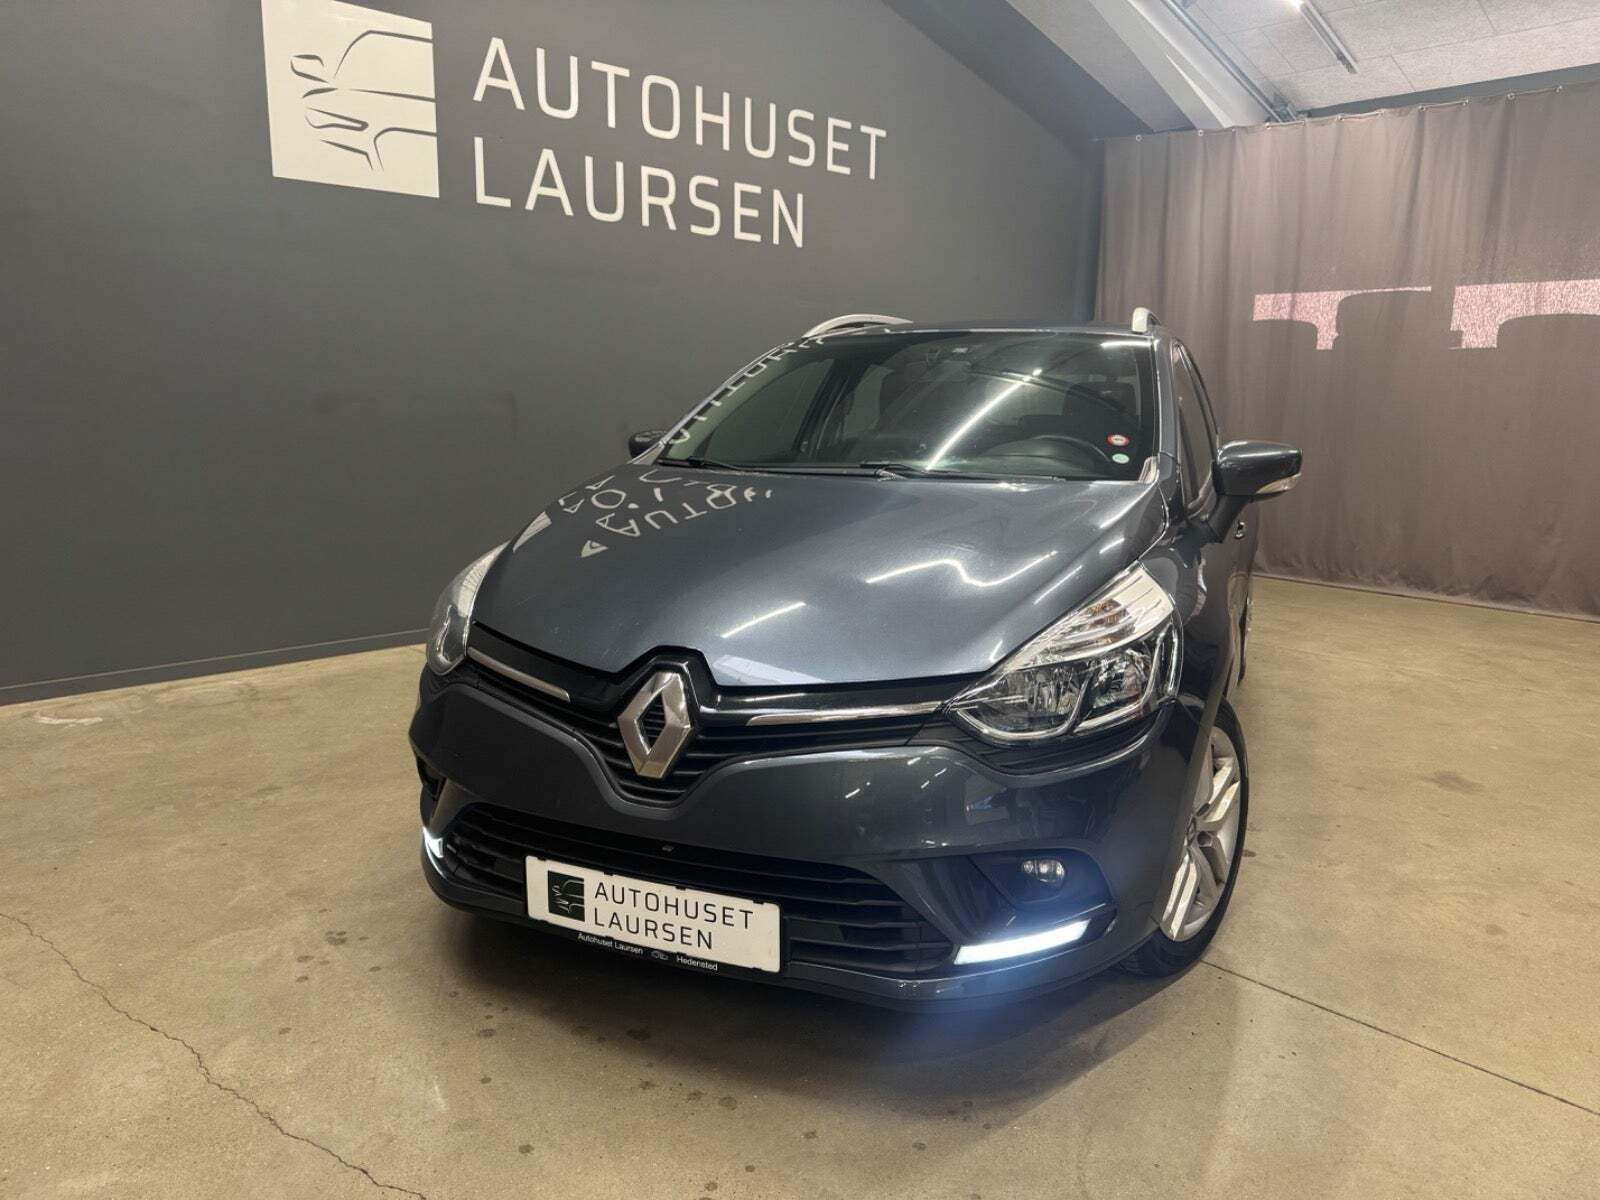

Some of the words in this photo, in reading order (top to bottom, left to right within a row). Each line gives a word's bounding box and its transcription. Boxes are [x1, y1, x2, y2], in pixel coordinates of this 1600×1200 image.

[473, 36, 887, 180] AUTOHUSET
[473, 136, 804, 248] LAURSEN
[594, 881, 754, 930] AUTOHUSET
[594, 908, 713, 950] LAURSEN
[577, 932, 614, 948] Autohuset
[614, 941, 644, 955] Laursen
[676, 956, 718, 971] Hedensted
